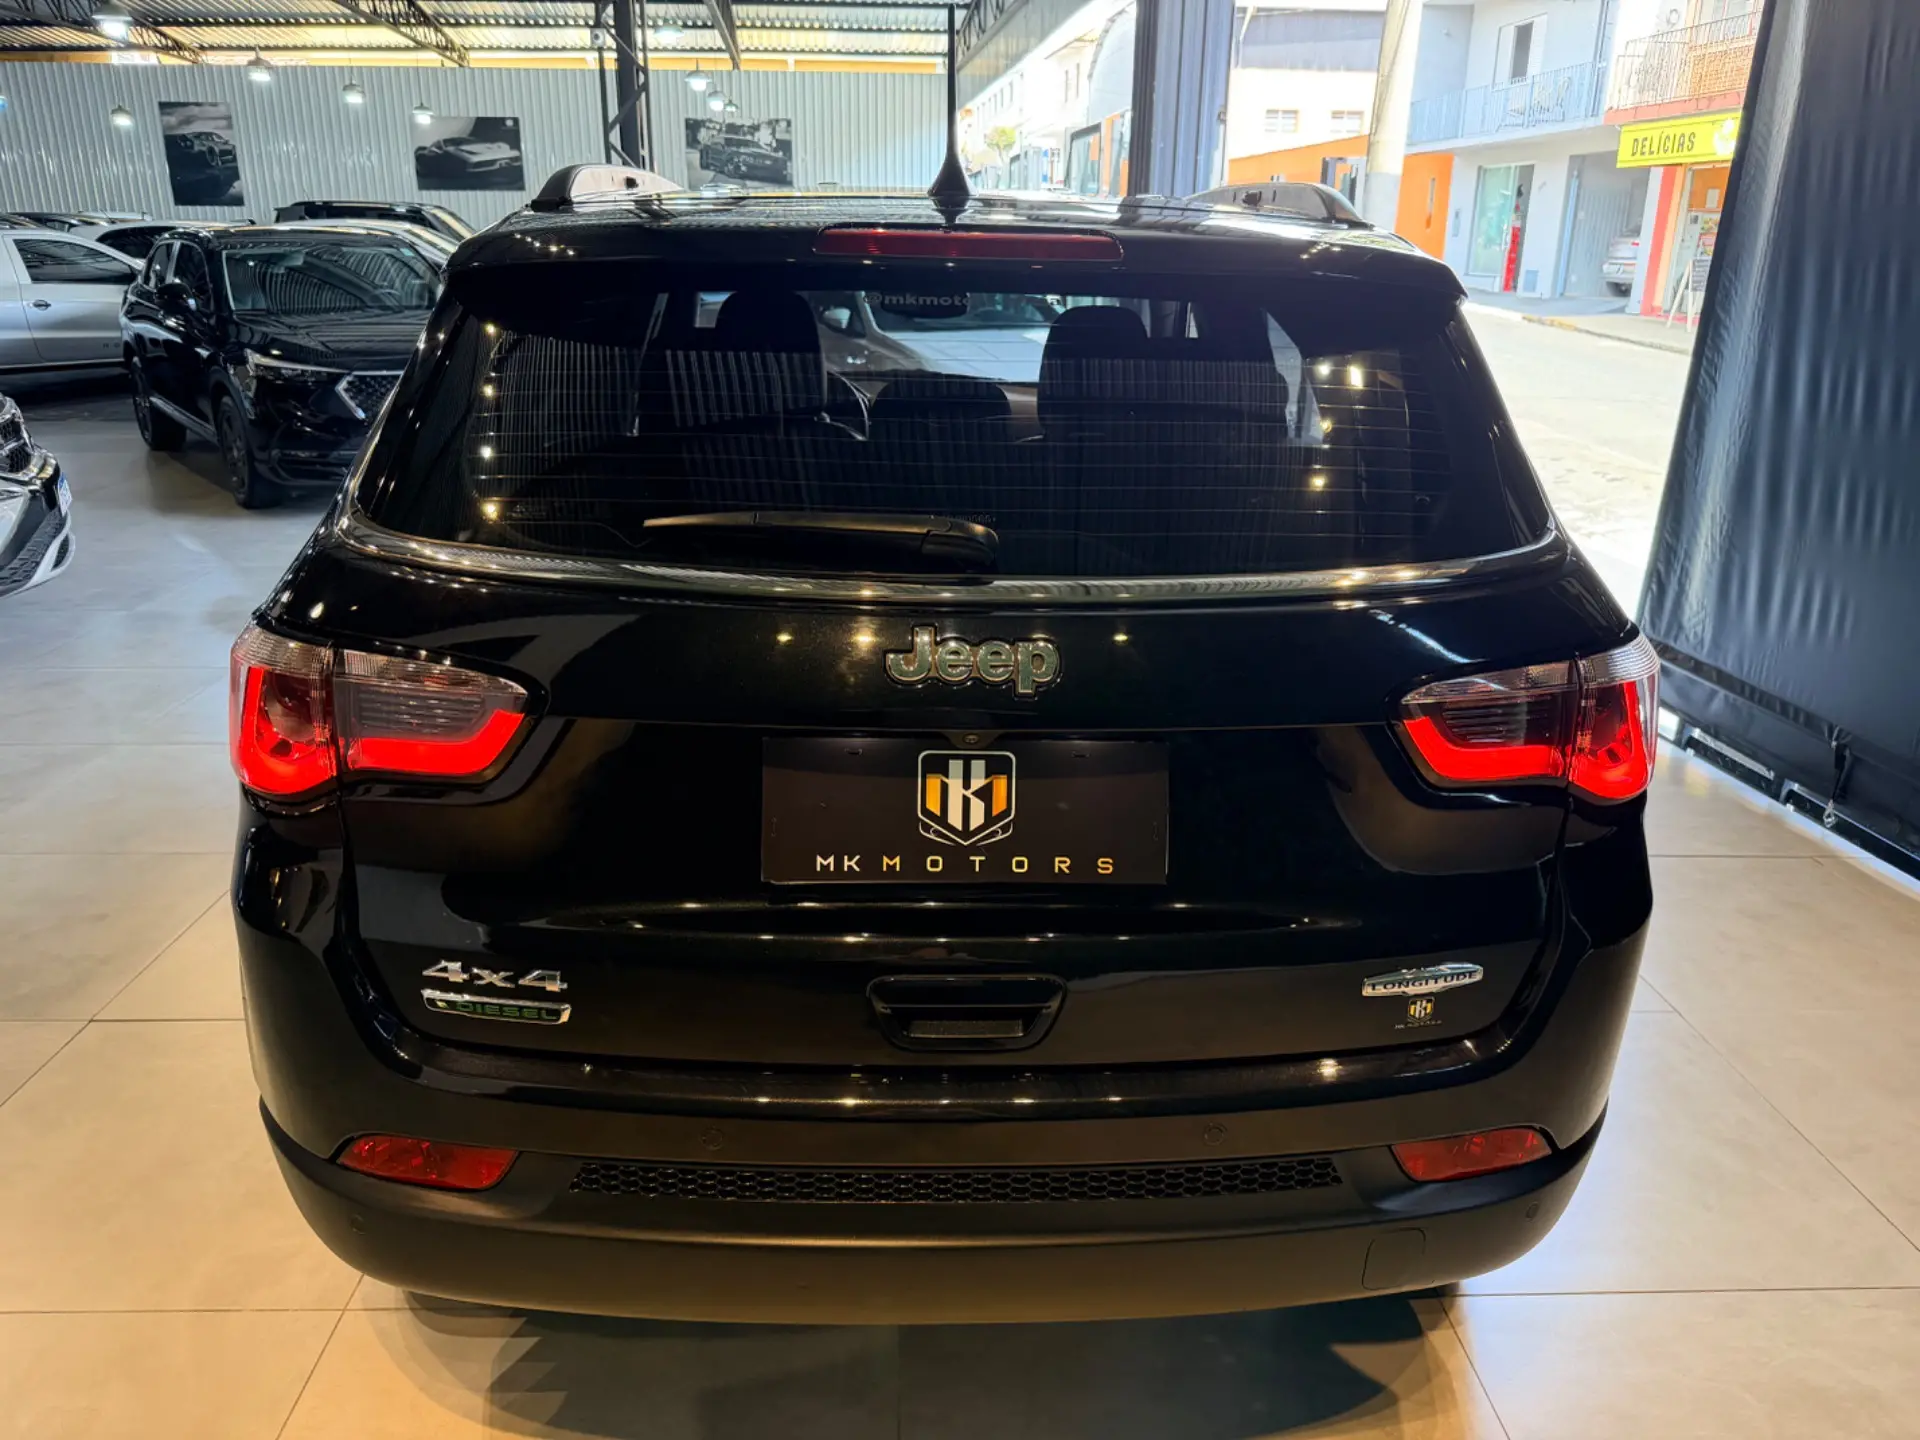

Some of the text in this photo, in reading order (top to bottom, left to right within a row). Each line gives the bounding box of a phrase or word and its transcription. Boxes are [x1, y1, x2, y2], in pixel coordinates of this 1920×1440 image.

[1631, 131, 1696, 156] DELÍCIAS
[886, 626, 1060, 694] Jeep
[882, 855, 1114, 874] MOTORS
[1369, 971, 1478, 991] LONGITUDE
[455, 1002, 557, 1020] DIESEL
